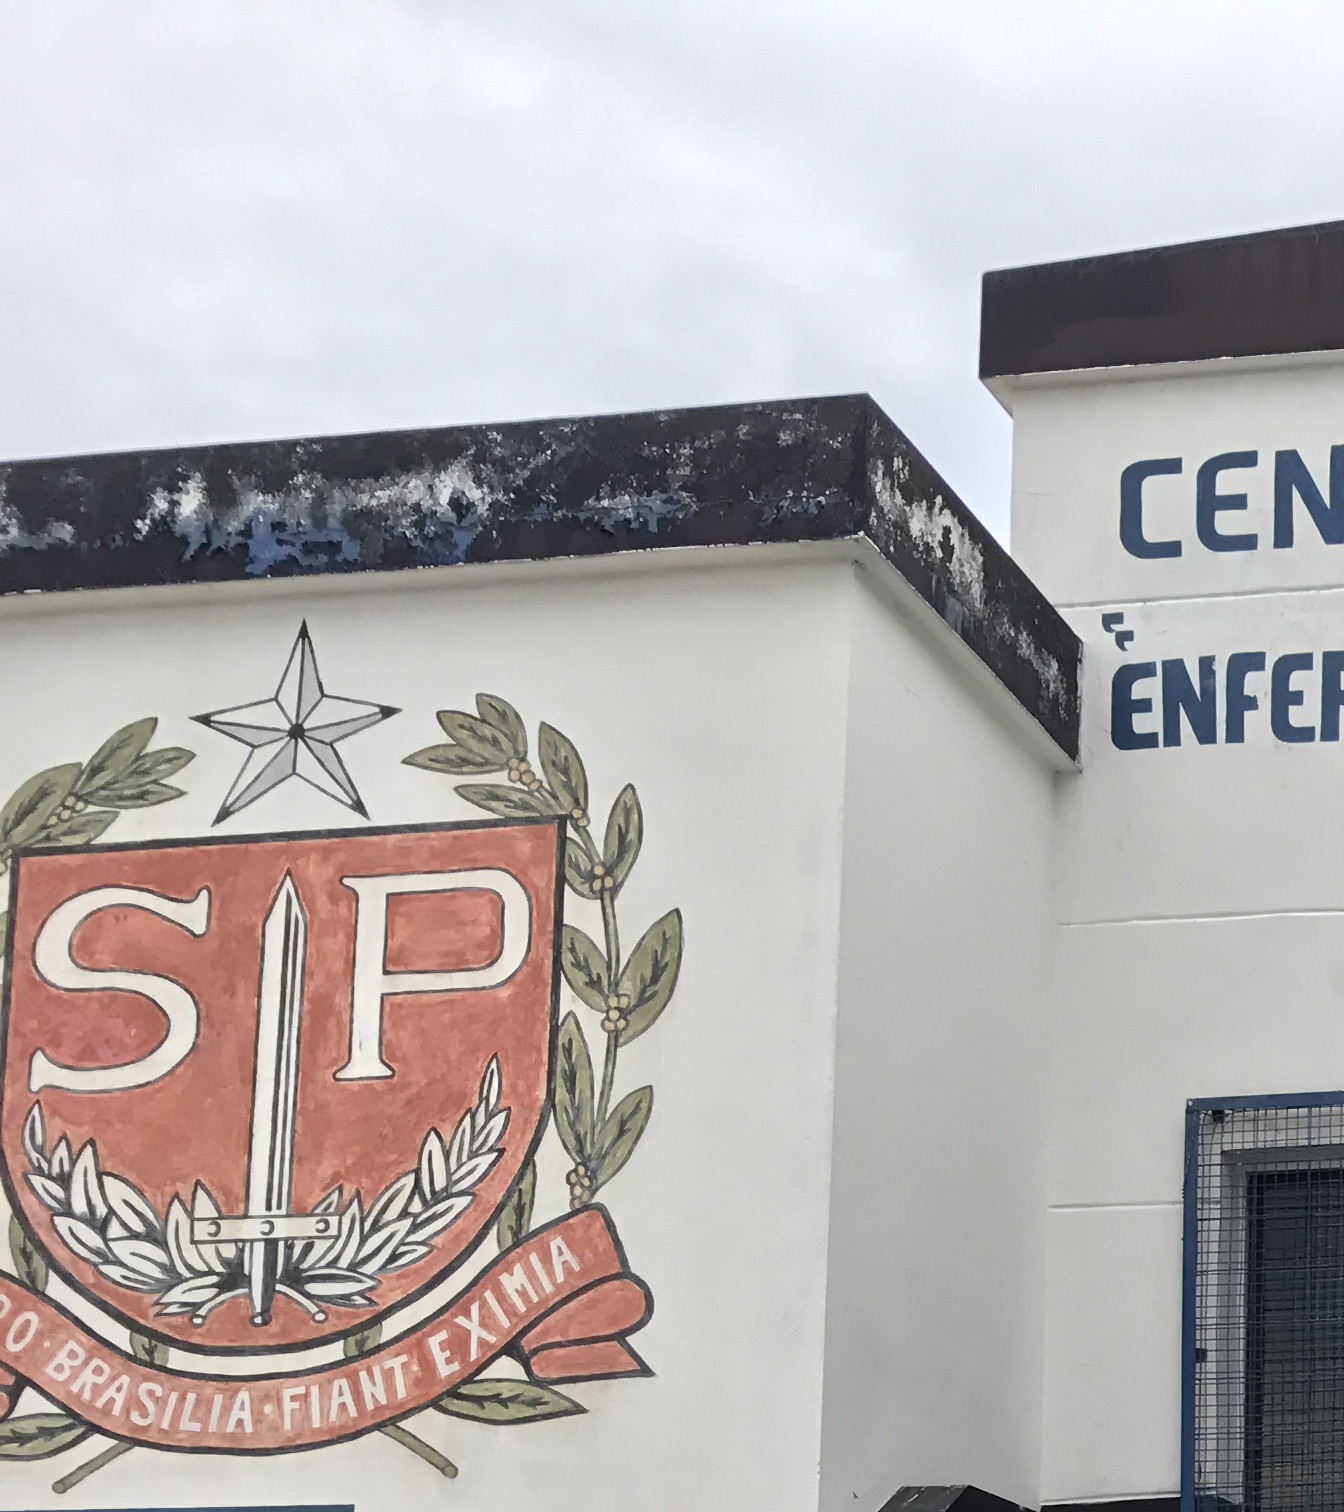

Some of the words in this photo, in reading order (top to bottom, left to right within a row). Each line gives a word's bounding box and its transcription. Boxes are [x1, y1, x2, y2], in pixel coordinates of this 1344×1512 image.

[28, 885, 210, 1094] S
[332, 866, 532, 1081] P
[45, 1338, 254, 1434] BRASILIA
[282, 1353, 410, 1431] FIANT
[427, 1235, 581, 1380] EXIMIA
